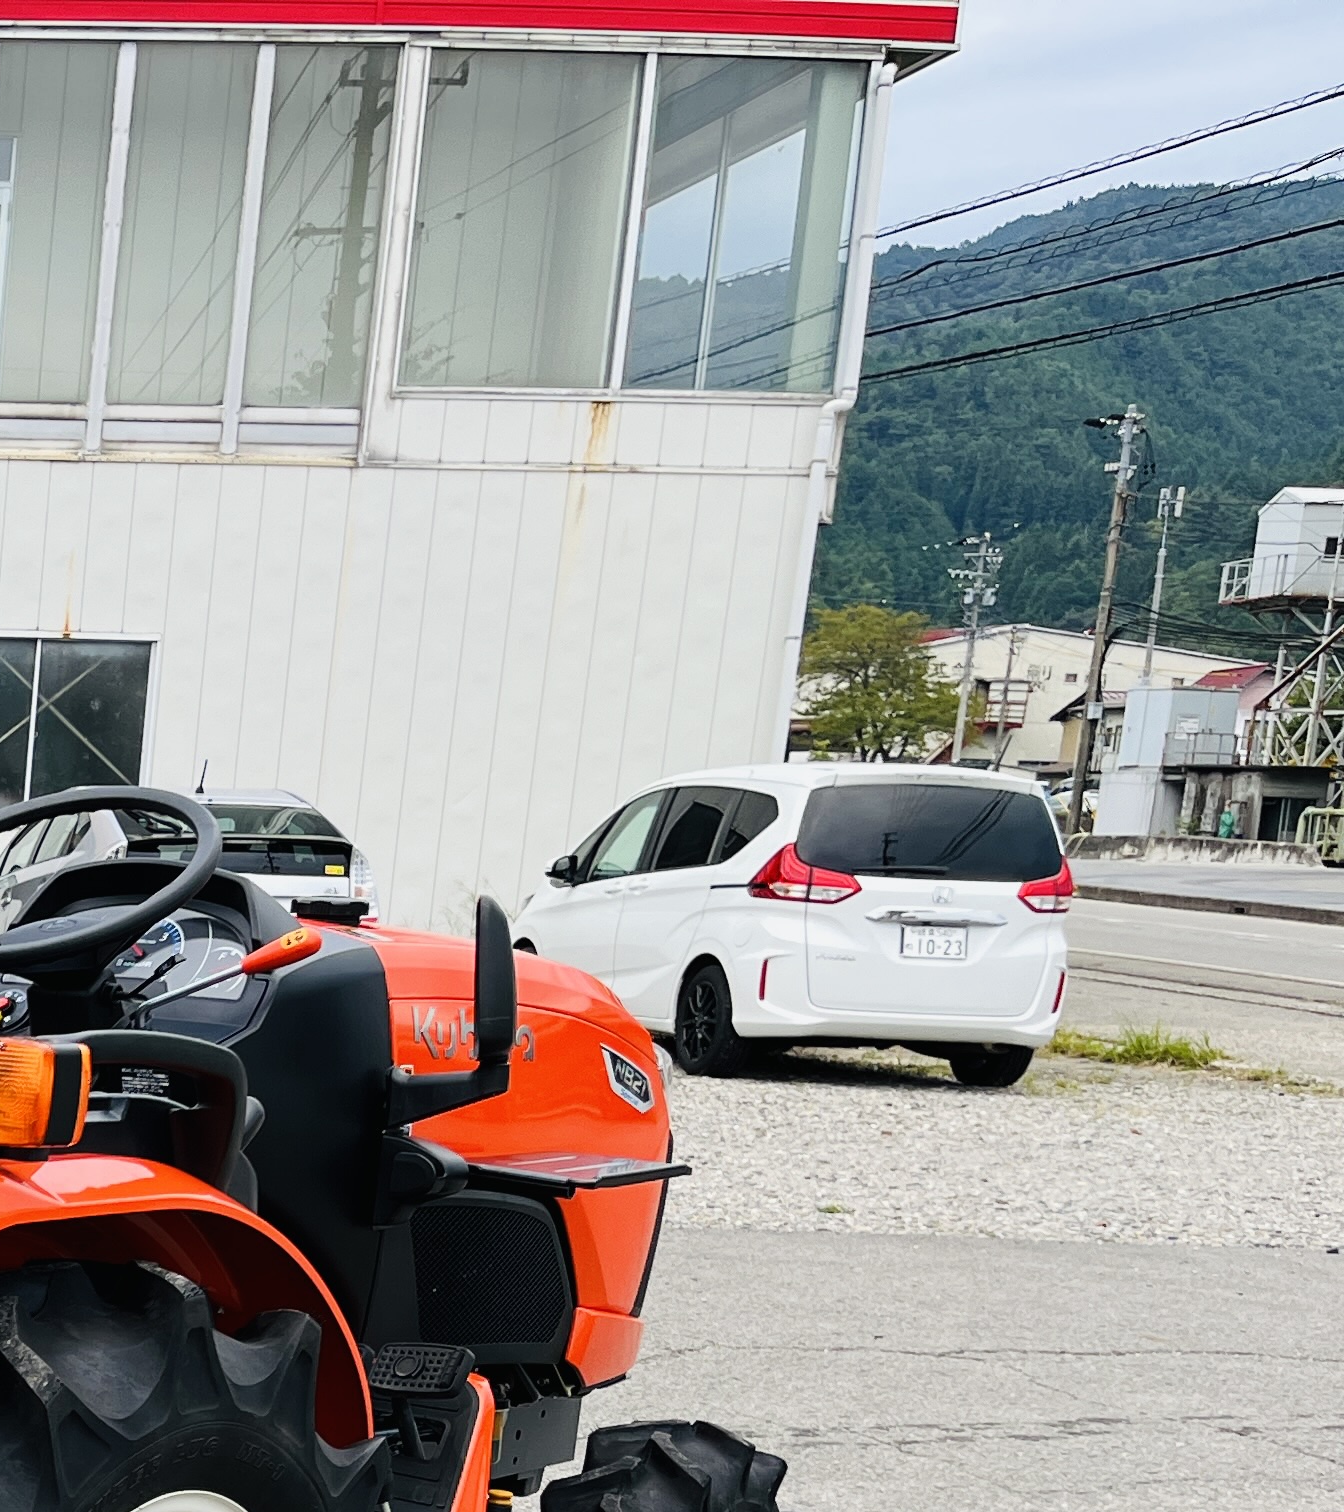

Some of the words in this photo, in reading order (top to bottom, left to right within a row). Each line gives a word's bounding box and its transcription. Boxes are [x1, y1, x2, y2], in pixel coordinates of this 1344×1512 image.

[918, 938, 963, 956] 10-23
[412, 1006, 535, 1062] Kuba
[614, 1058, 647, 1097] NB21
